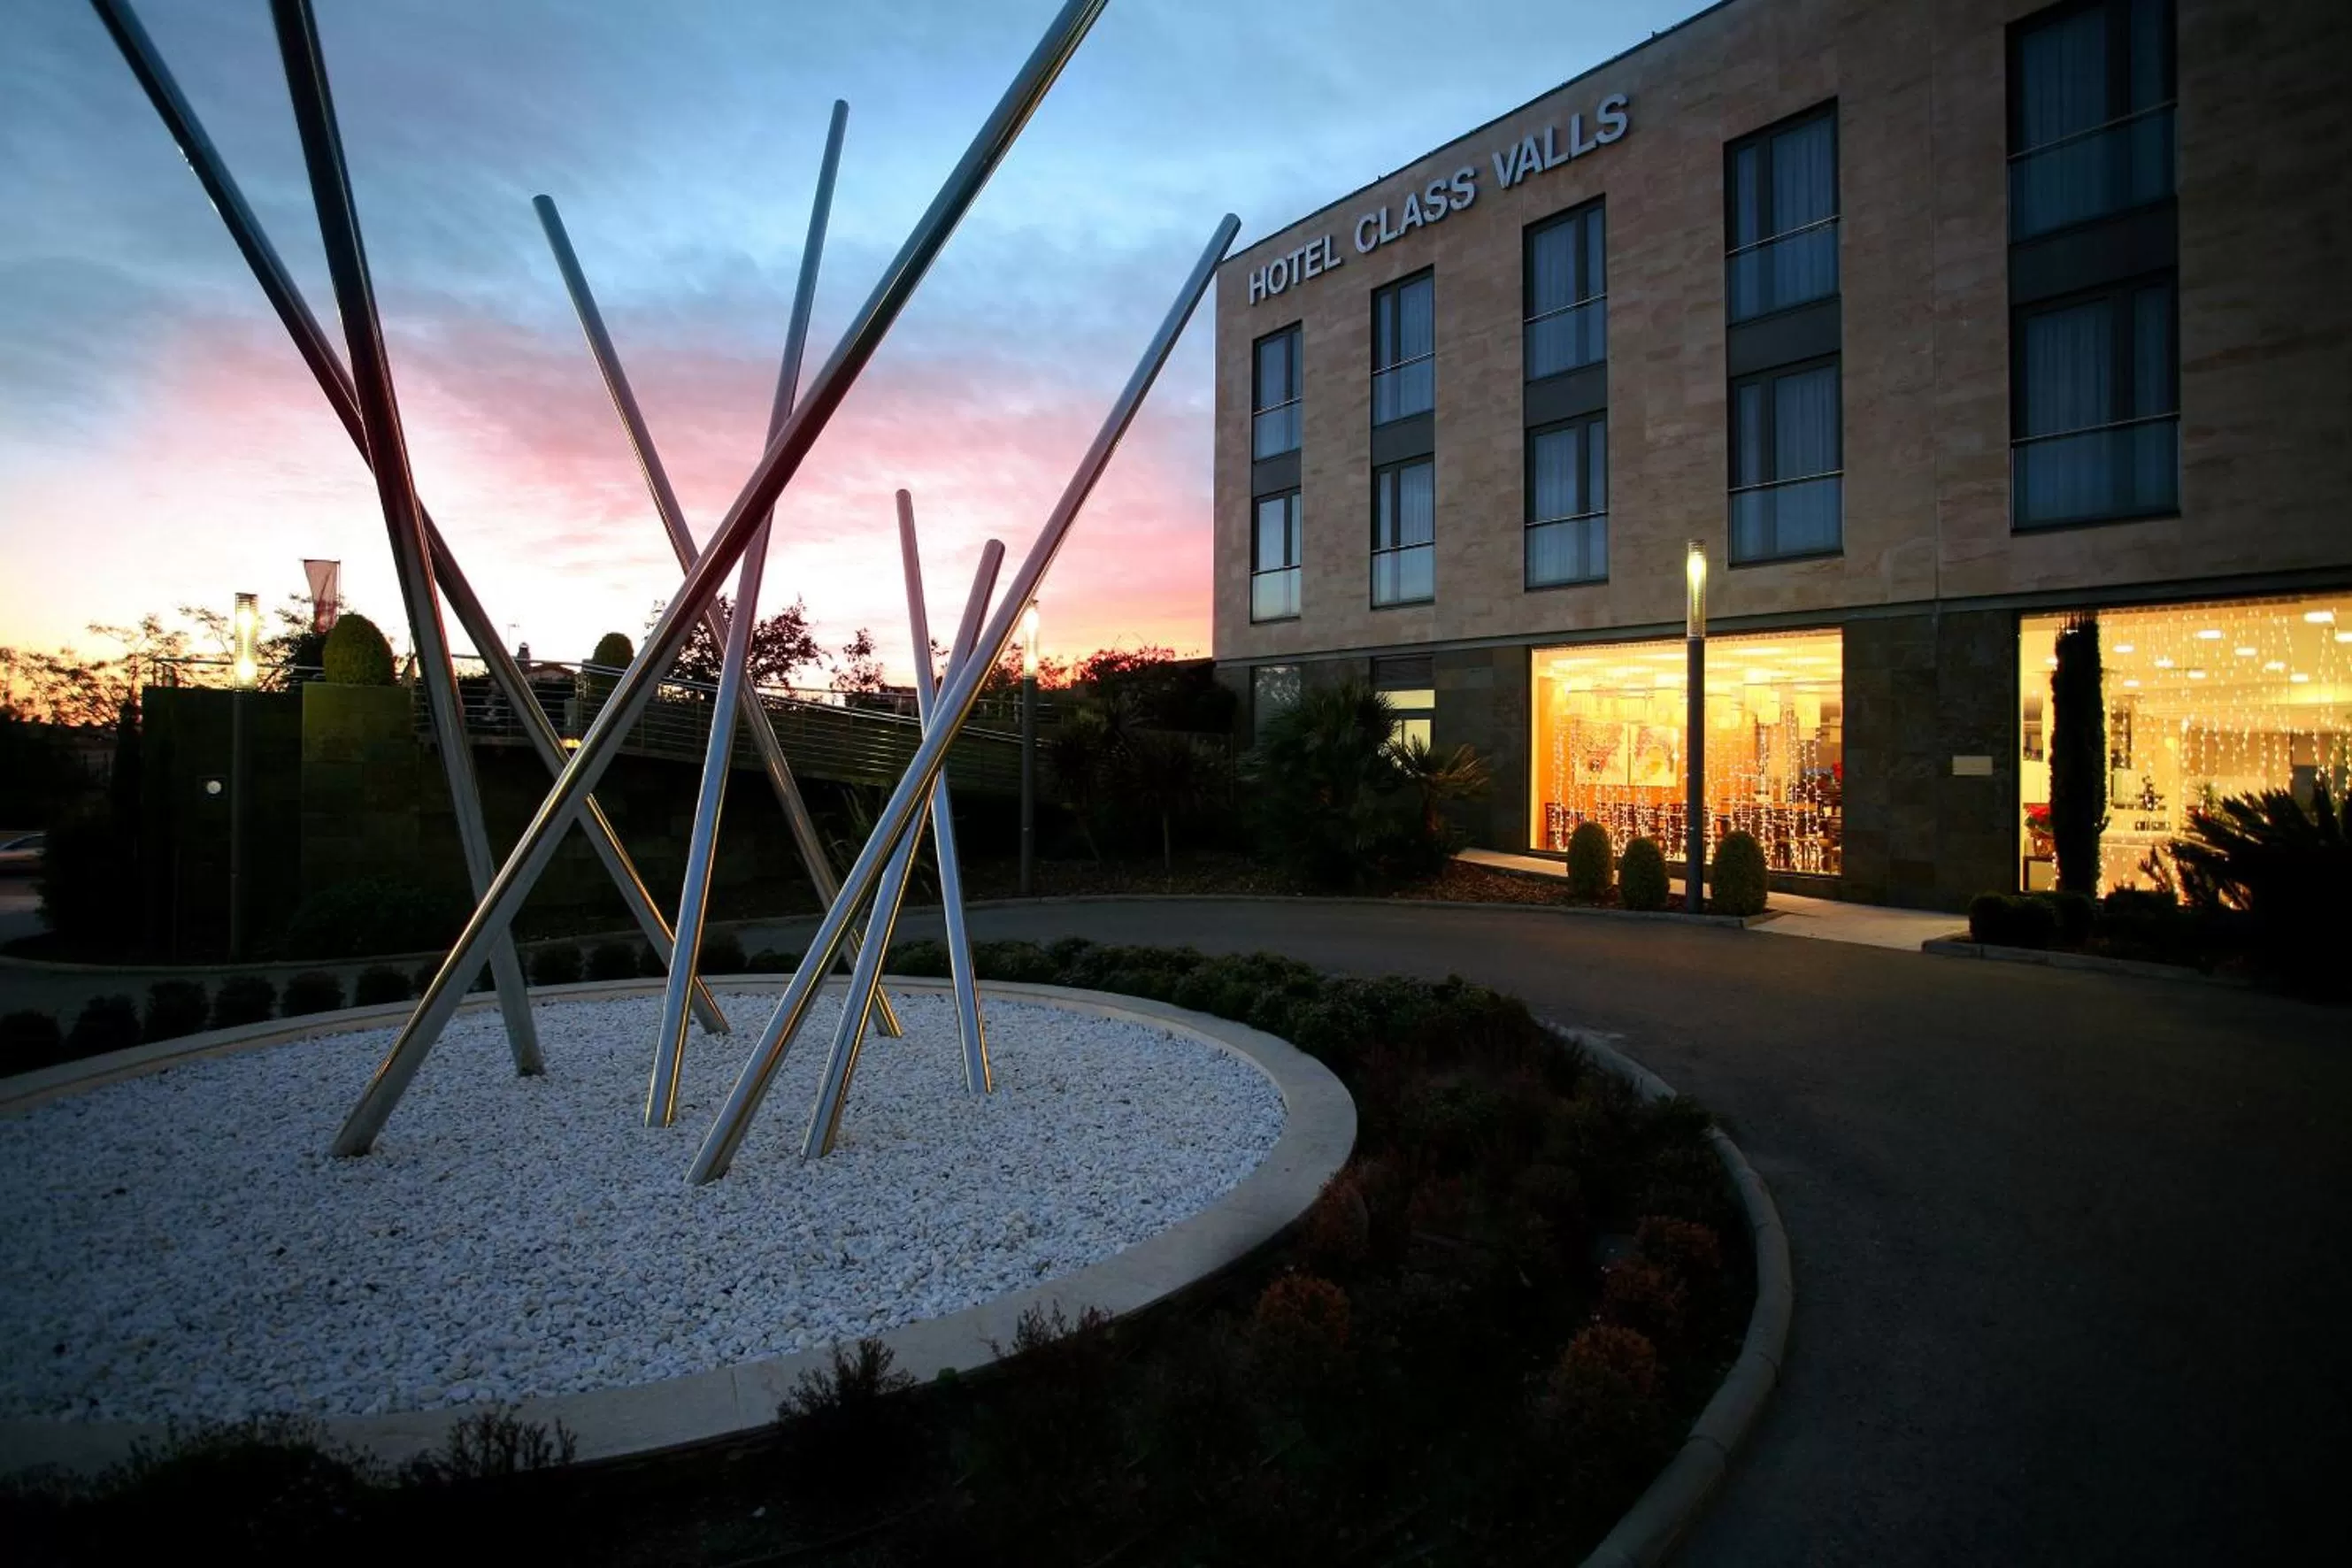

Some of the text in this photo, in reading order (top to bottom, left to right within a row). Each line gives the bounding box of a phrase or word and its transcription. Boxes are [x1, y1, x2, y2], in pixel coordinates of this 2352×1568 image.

[1249, 93, 1630, 305] HOTEL CLASS VALLS
